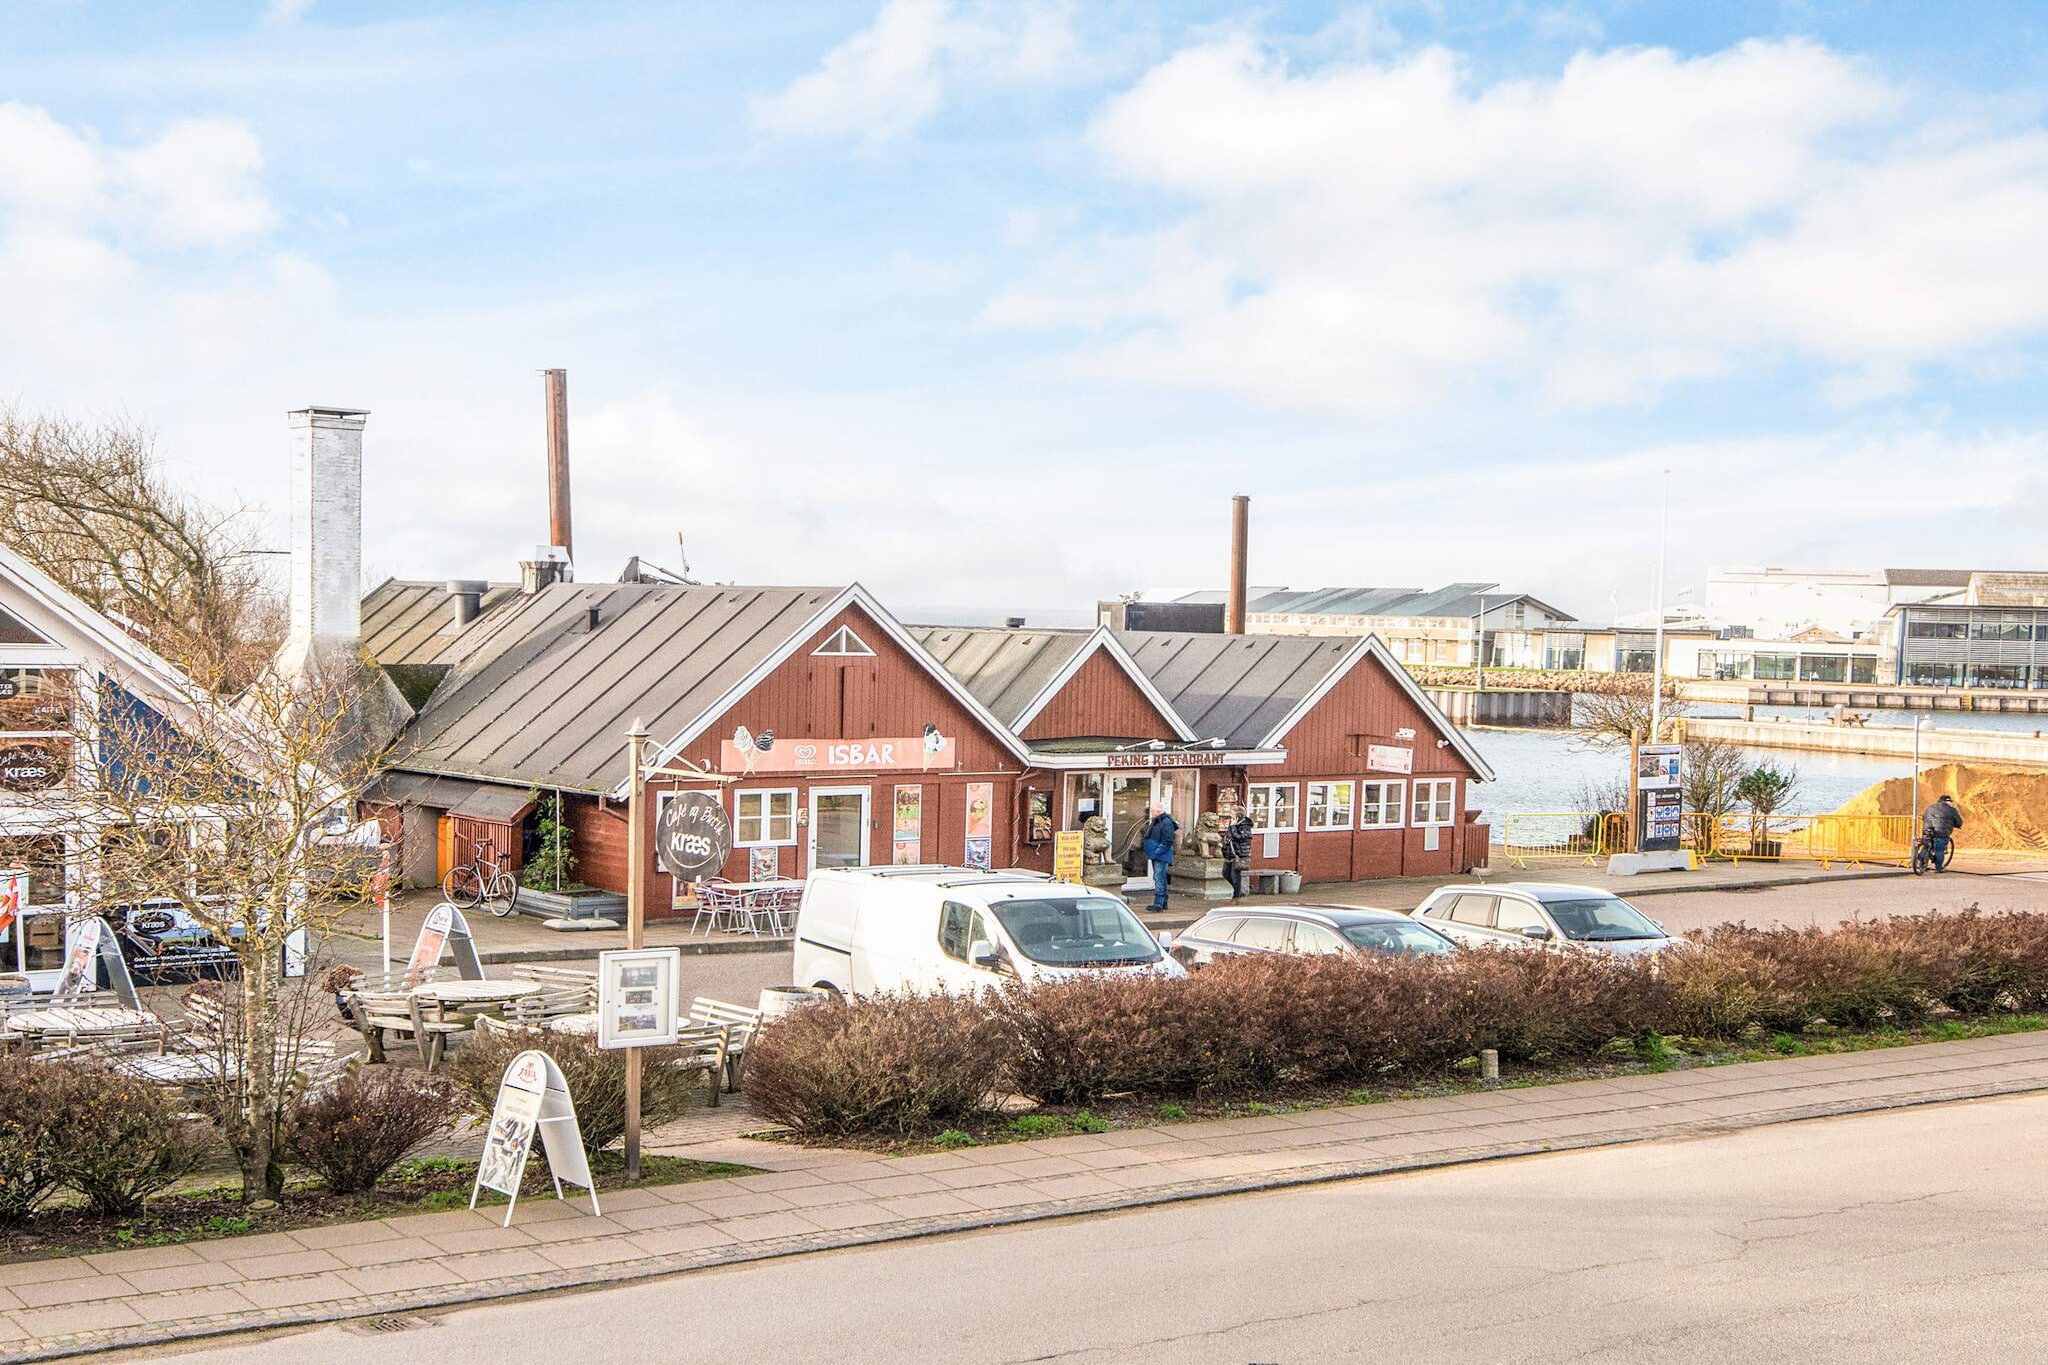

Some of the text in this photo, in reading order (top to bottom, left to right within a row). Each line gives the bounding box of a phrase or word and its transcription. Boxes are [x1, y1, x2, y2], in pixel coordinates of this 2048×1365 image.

[828, 743, 896, 765] ISBAR
[1107, 753, 1226, 766] PEKING RESTAURANT
[4, 767, 47, 777] kræs
[666, 803, 687, 827] Café
[689, 806, 700, 823] og
[671, 831, 711, 856] kræs
